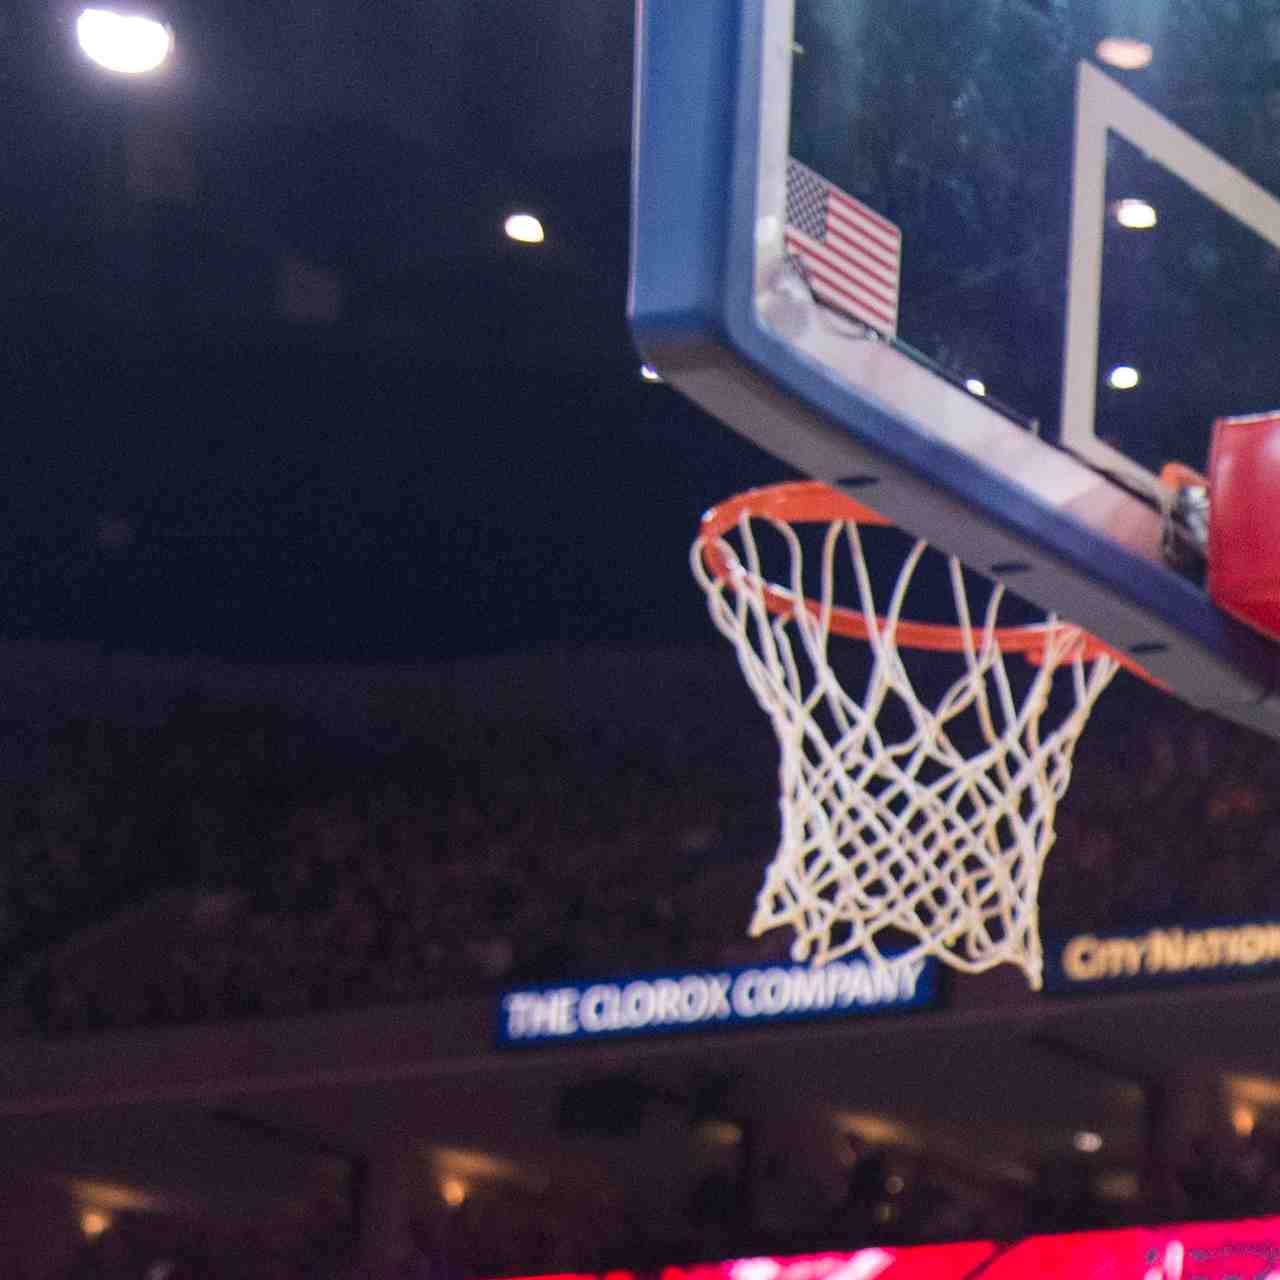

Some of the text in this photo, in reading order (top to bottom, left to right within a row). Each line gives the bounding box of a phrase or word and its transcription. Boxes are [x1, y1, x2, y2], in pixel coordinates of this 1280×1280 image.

[507, 958, 926, 1040] THE CLOROX COMPANY
